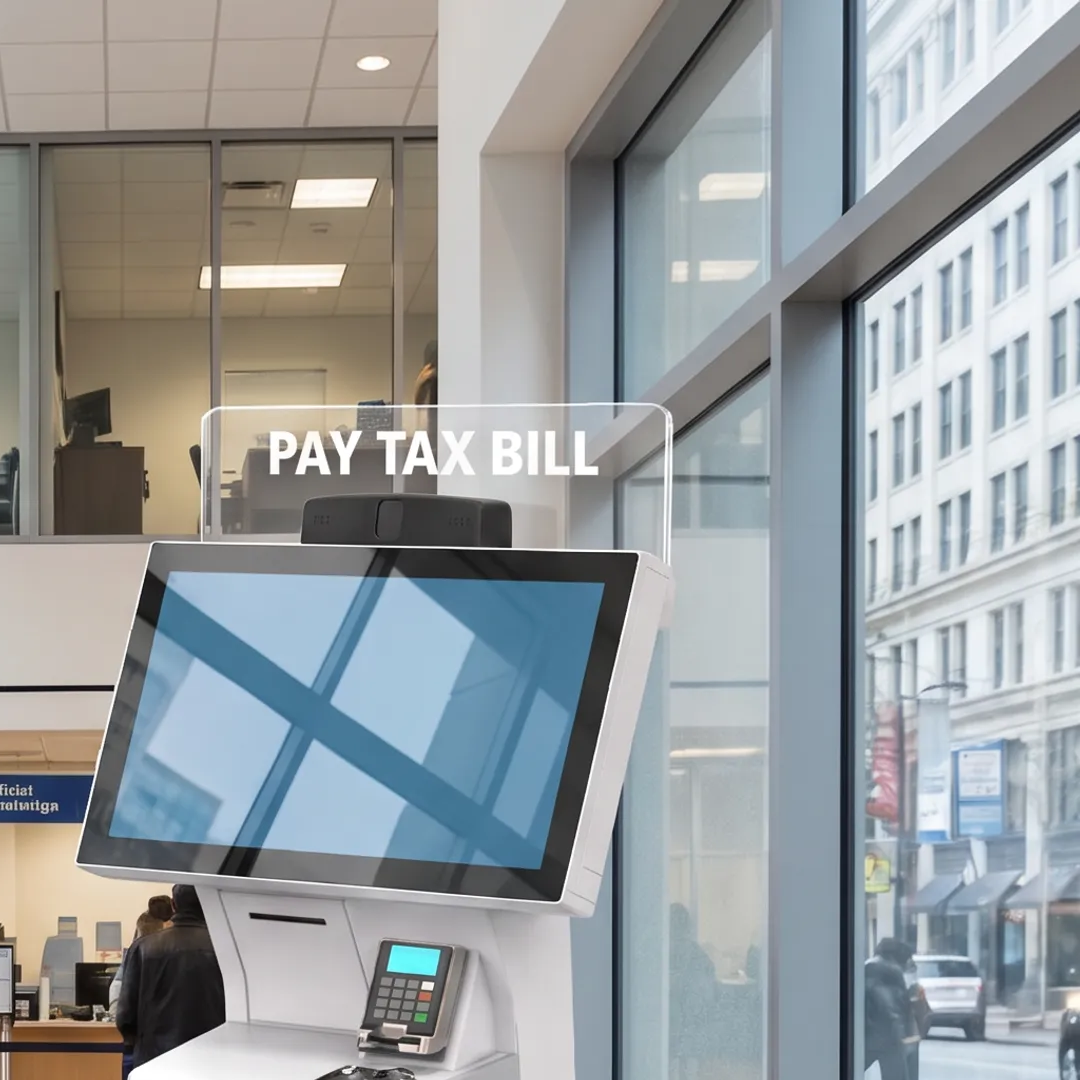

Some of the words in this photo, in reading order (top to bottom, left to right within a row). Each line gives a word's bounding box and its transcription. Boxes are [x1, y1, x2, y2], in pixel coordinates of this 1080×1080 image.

[269, 430, 363, 476] PAY
[377, 430, 475, 476] TAX
[491, 430, 599, 476] BILL
